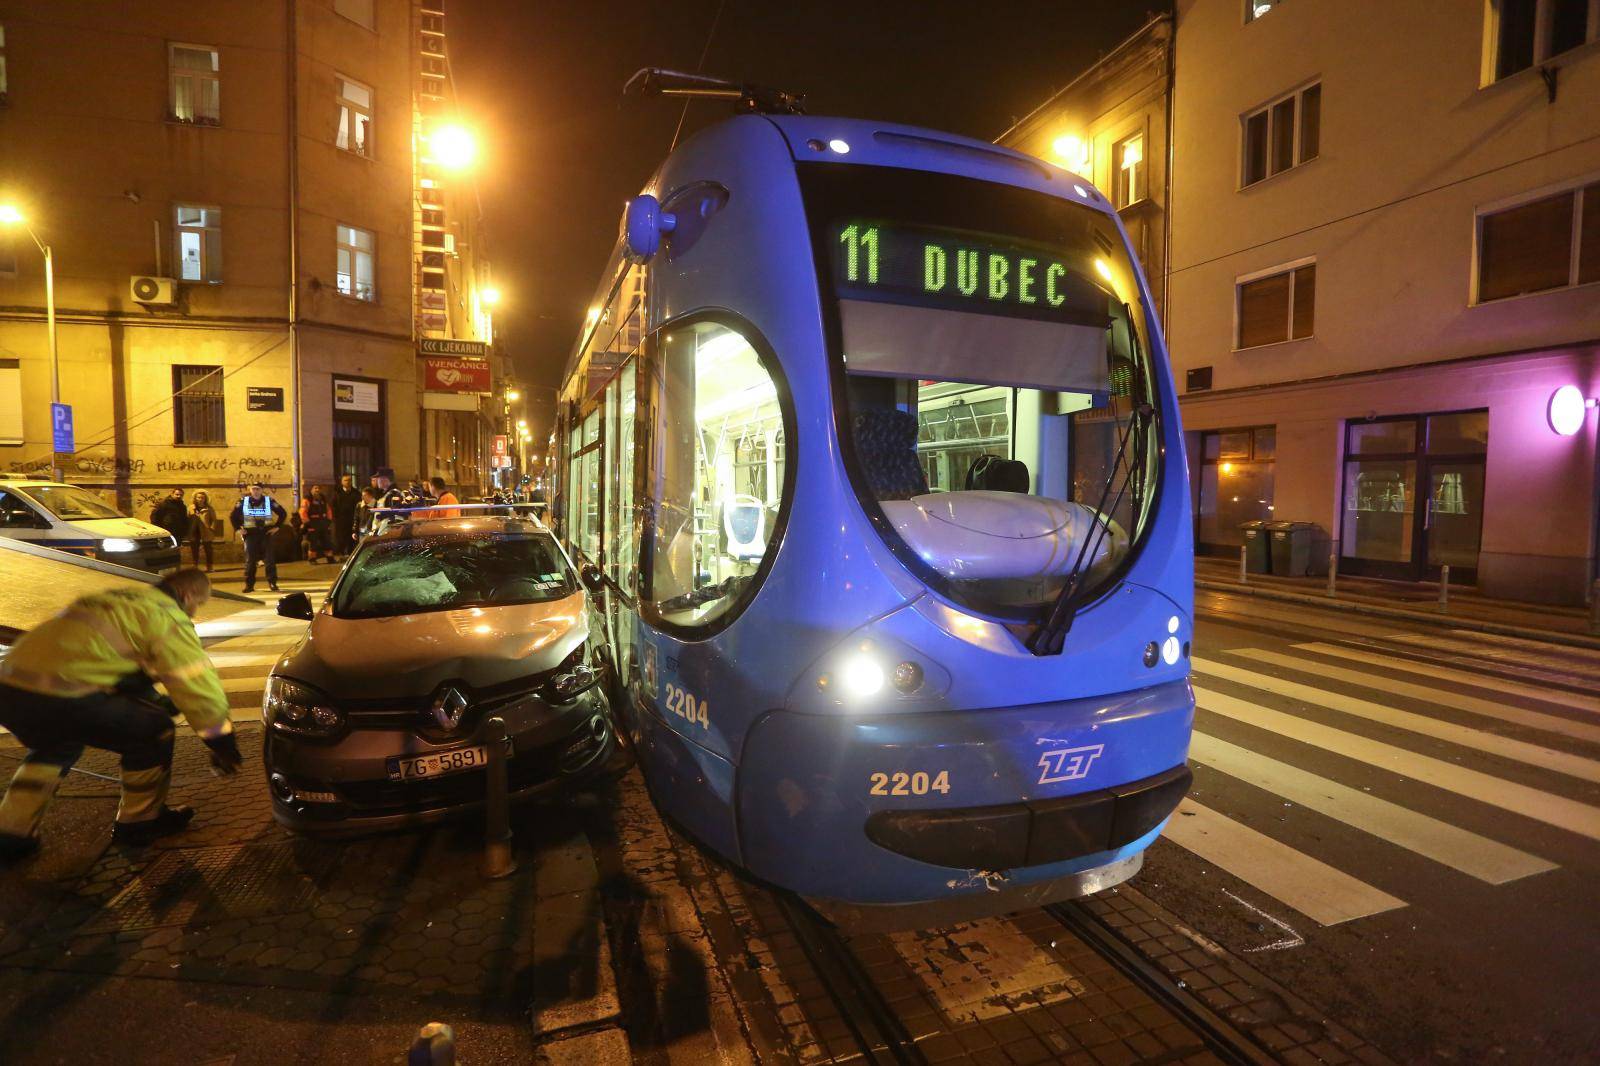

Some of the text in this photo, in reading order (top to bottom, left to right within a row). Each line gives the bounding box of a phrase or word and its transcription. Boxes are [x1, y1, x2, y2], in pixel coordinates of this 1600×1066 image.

[840, 225, 1065, 306] 11 DUBEC
[440, 342, 483, 354] LJEKARNA
[55, 406, 65, 430] P
[665, 683, 710, 731] 2204
[401, 759, 427, 777] ZG
[440, 748, 485, 771] 5891
[869, 770, 951, 796] 2204
